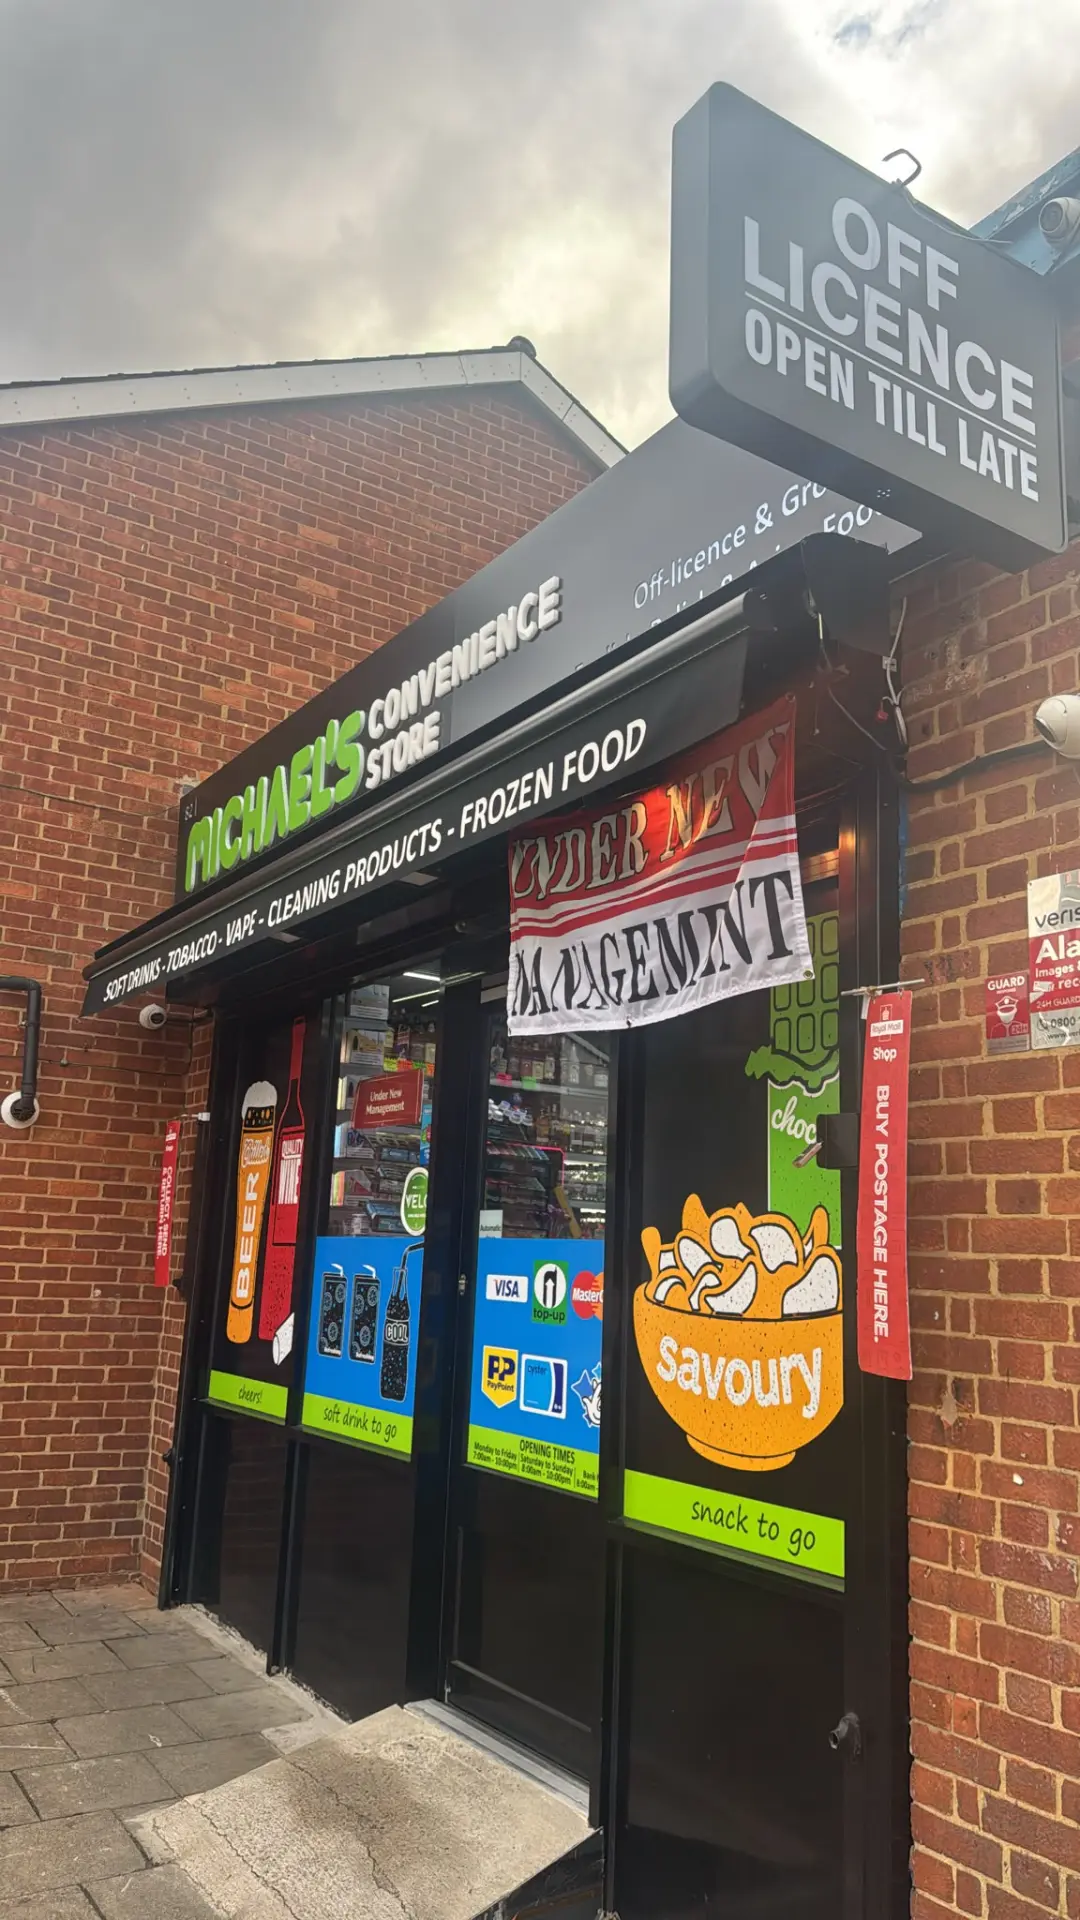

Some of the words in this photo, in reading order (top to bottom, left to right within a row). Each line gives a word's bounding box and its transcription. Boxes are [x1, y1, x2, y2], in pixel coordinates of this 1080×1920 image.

[832, 197, 958, 311] OFF
[744, 216, 1036, 436] LICENCE
[745, 308, 854, 410] OPEN
[868, 371, 946, 456] TILL
[958, 418, 1039, 502] LATE
[823, 504, 881, 536] Foo
[633, 524, 746, 610] Off-licence
[754, 502, 774, 535] &
[368, 575, 562, 740] CONVENIENCE
[364, 710, 441, 790] STORE
[184, 709, 366, 893] MICHAEL'S
[102, 973, 128, 1002] SOFT
[127, 957, 162, 993] DRINKS
[166, 930, 218, 973] TOBACCO
[226, 909, 258, 947] VAPE
[267, 868, 341, 927] CLEANING
[343, 817, 443, 893] PRODUCTS
[459, 761, 554, 839] FROZEN
[561, 717, 647, 792] FOOD
[510, 800, 649, 901] UNDER
[1034, 934, 1080, 965] Ala
[987, 975, 1026, 991] GUARD
[1035, 964, 1075, 978] Images
[1058, 977, 1080, 990] rec
[1036, 1000, 1052, 1009] 24H
[1050, 1016, 1076, 1028] 0800
[873, 1046, 897, 1062] Shop
[365, 1100, 405, 1116] Management
[370, 1089, 388, 1102] Under
[389, 1087, 402, 1099] New
[874, 1084, 890, 1137] BUY
[872, 1143, 889, 1263] POSTAGE
[161, 1223, 169, 1256] SEND
[236, 1171, 260, 1298] BEER
[494, 1279, 520, 1298] VISA
[533, 1307, 566, 1324] top-up
[872, 1267, 889, 1343] HERE.
[385, 1323, 409, 1342] COOL
[238, 1383, 264, 1405] cheers!
[487, 1379, 515, 1392] PayPoint
[323, 1405, 340, 1423] soft
[343, 1409, 369, 1436] drink
[371, 1418, 382, 1435] to
[384, 1426, 398, 1443] go
[474, 1441, 494, 1456] Monday
[501, 1448, 517, 1462] Friday
[520, 1439, 551, 1459] OPENING
[553, 1446, 575, 1465] TIMES
[520, 1453, 544, 1470] Saturday
[552, 1462, 574, 1478] Sunday
[691, 1500, 748, 1534] snack
[758, 1516, 780, 1541] to
[787, 1528, 816, 1556] go
